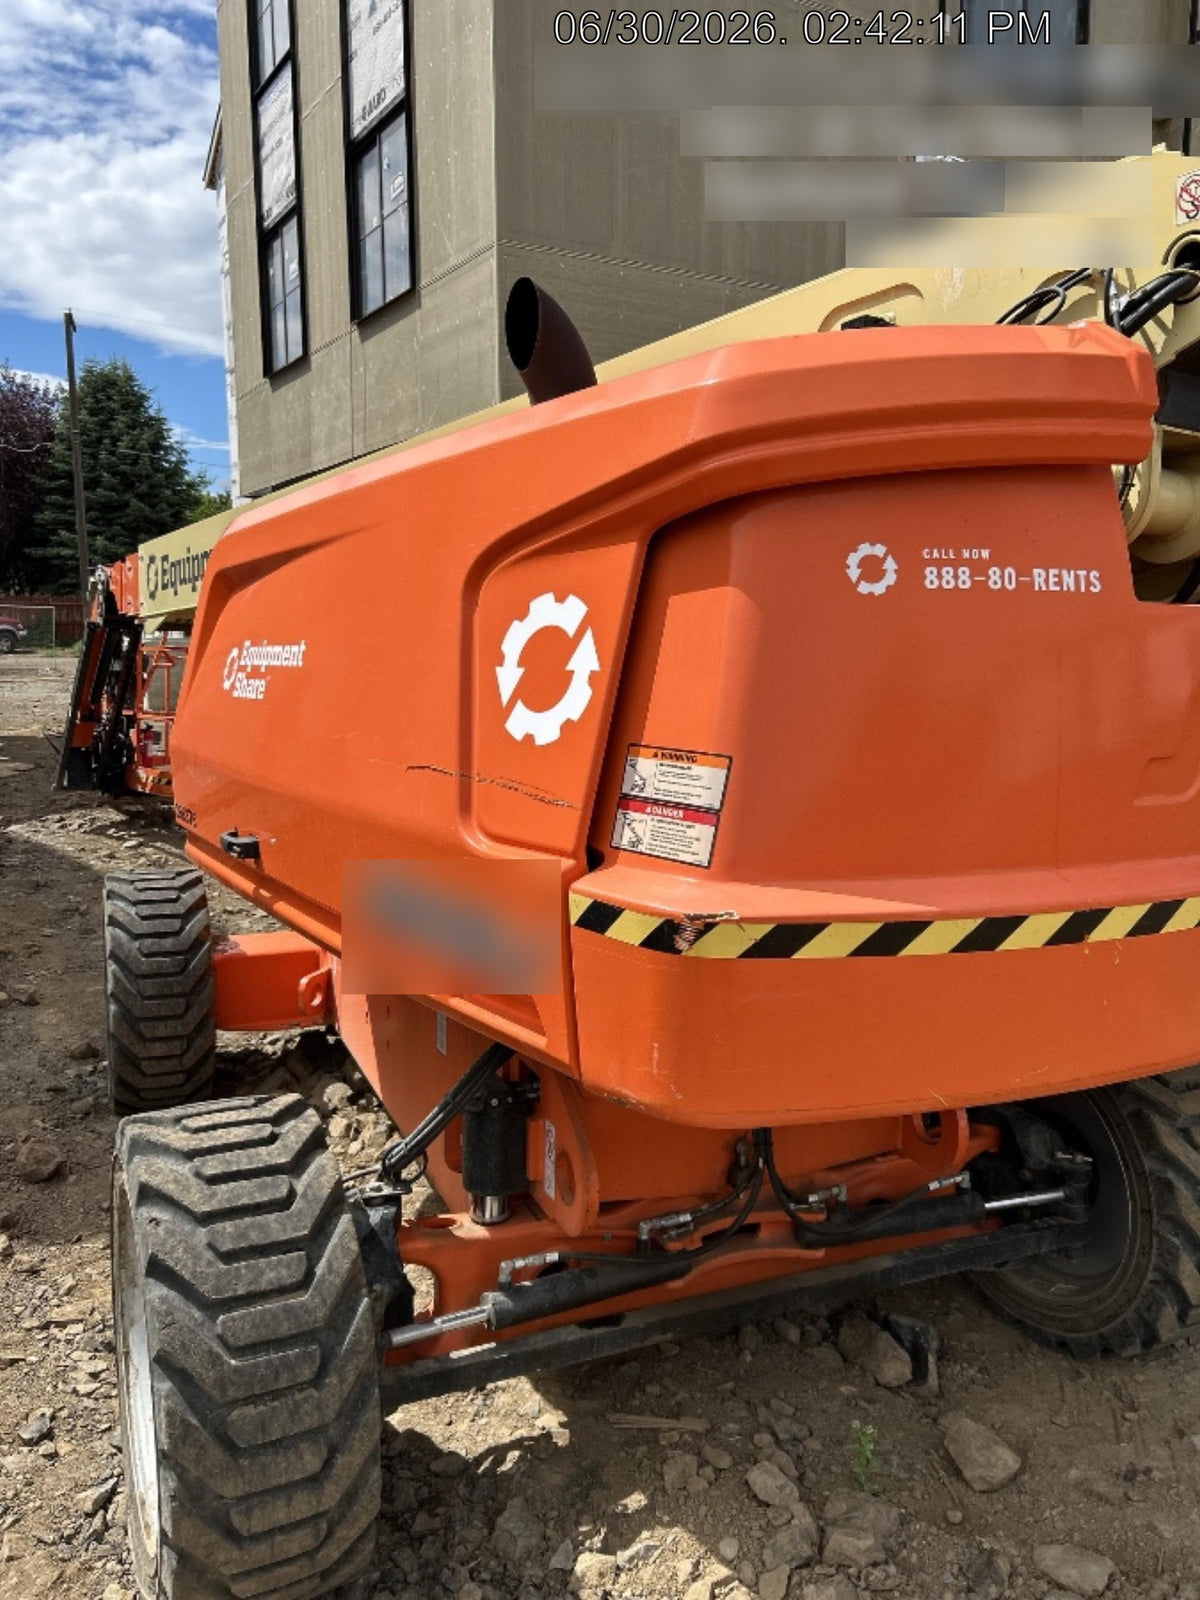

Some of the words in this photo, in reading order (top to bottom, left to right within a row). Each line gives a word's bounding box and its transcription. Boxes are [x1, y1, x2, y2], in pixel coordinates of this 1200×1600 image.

[922, 548, 957, 560] CALL
[962, 548, 991, 561] NOW
[924, 566, 1102, 593] 888-80-RENTS
[240, 639, 306, 673] Equipment
[233, 671, 267, 700] Share
[652, 806, 684, 819] DANGER
